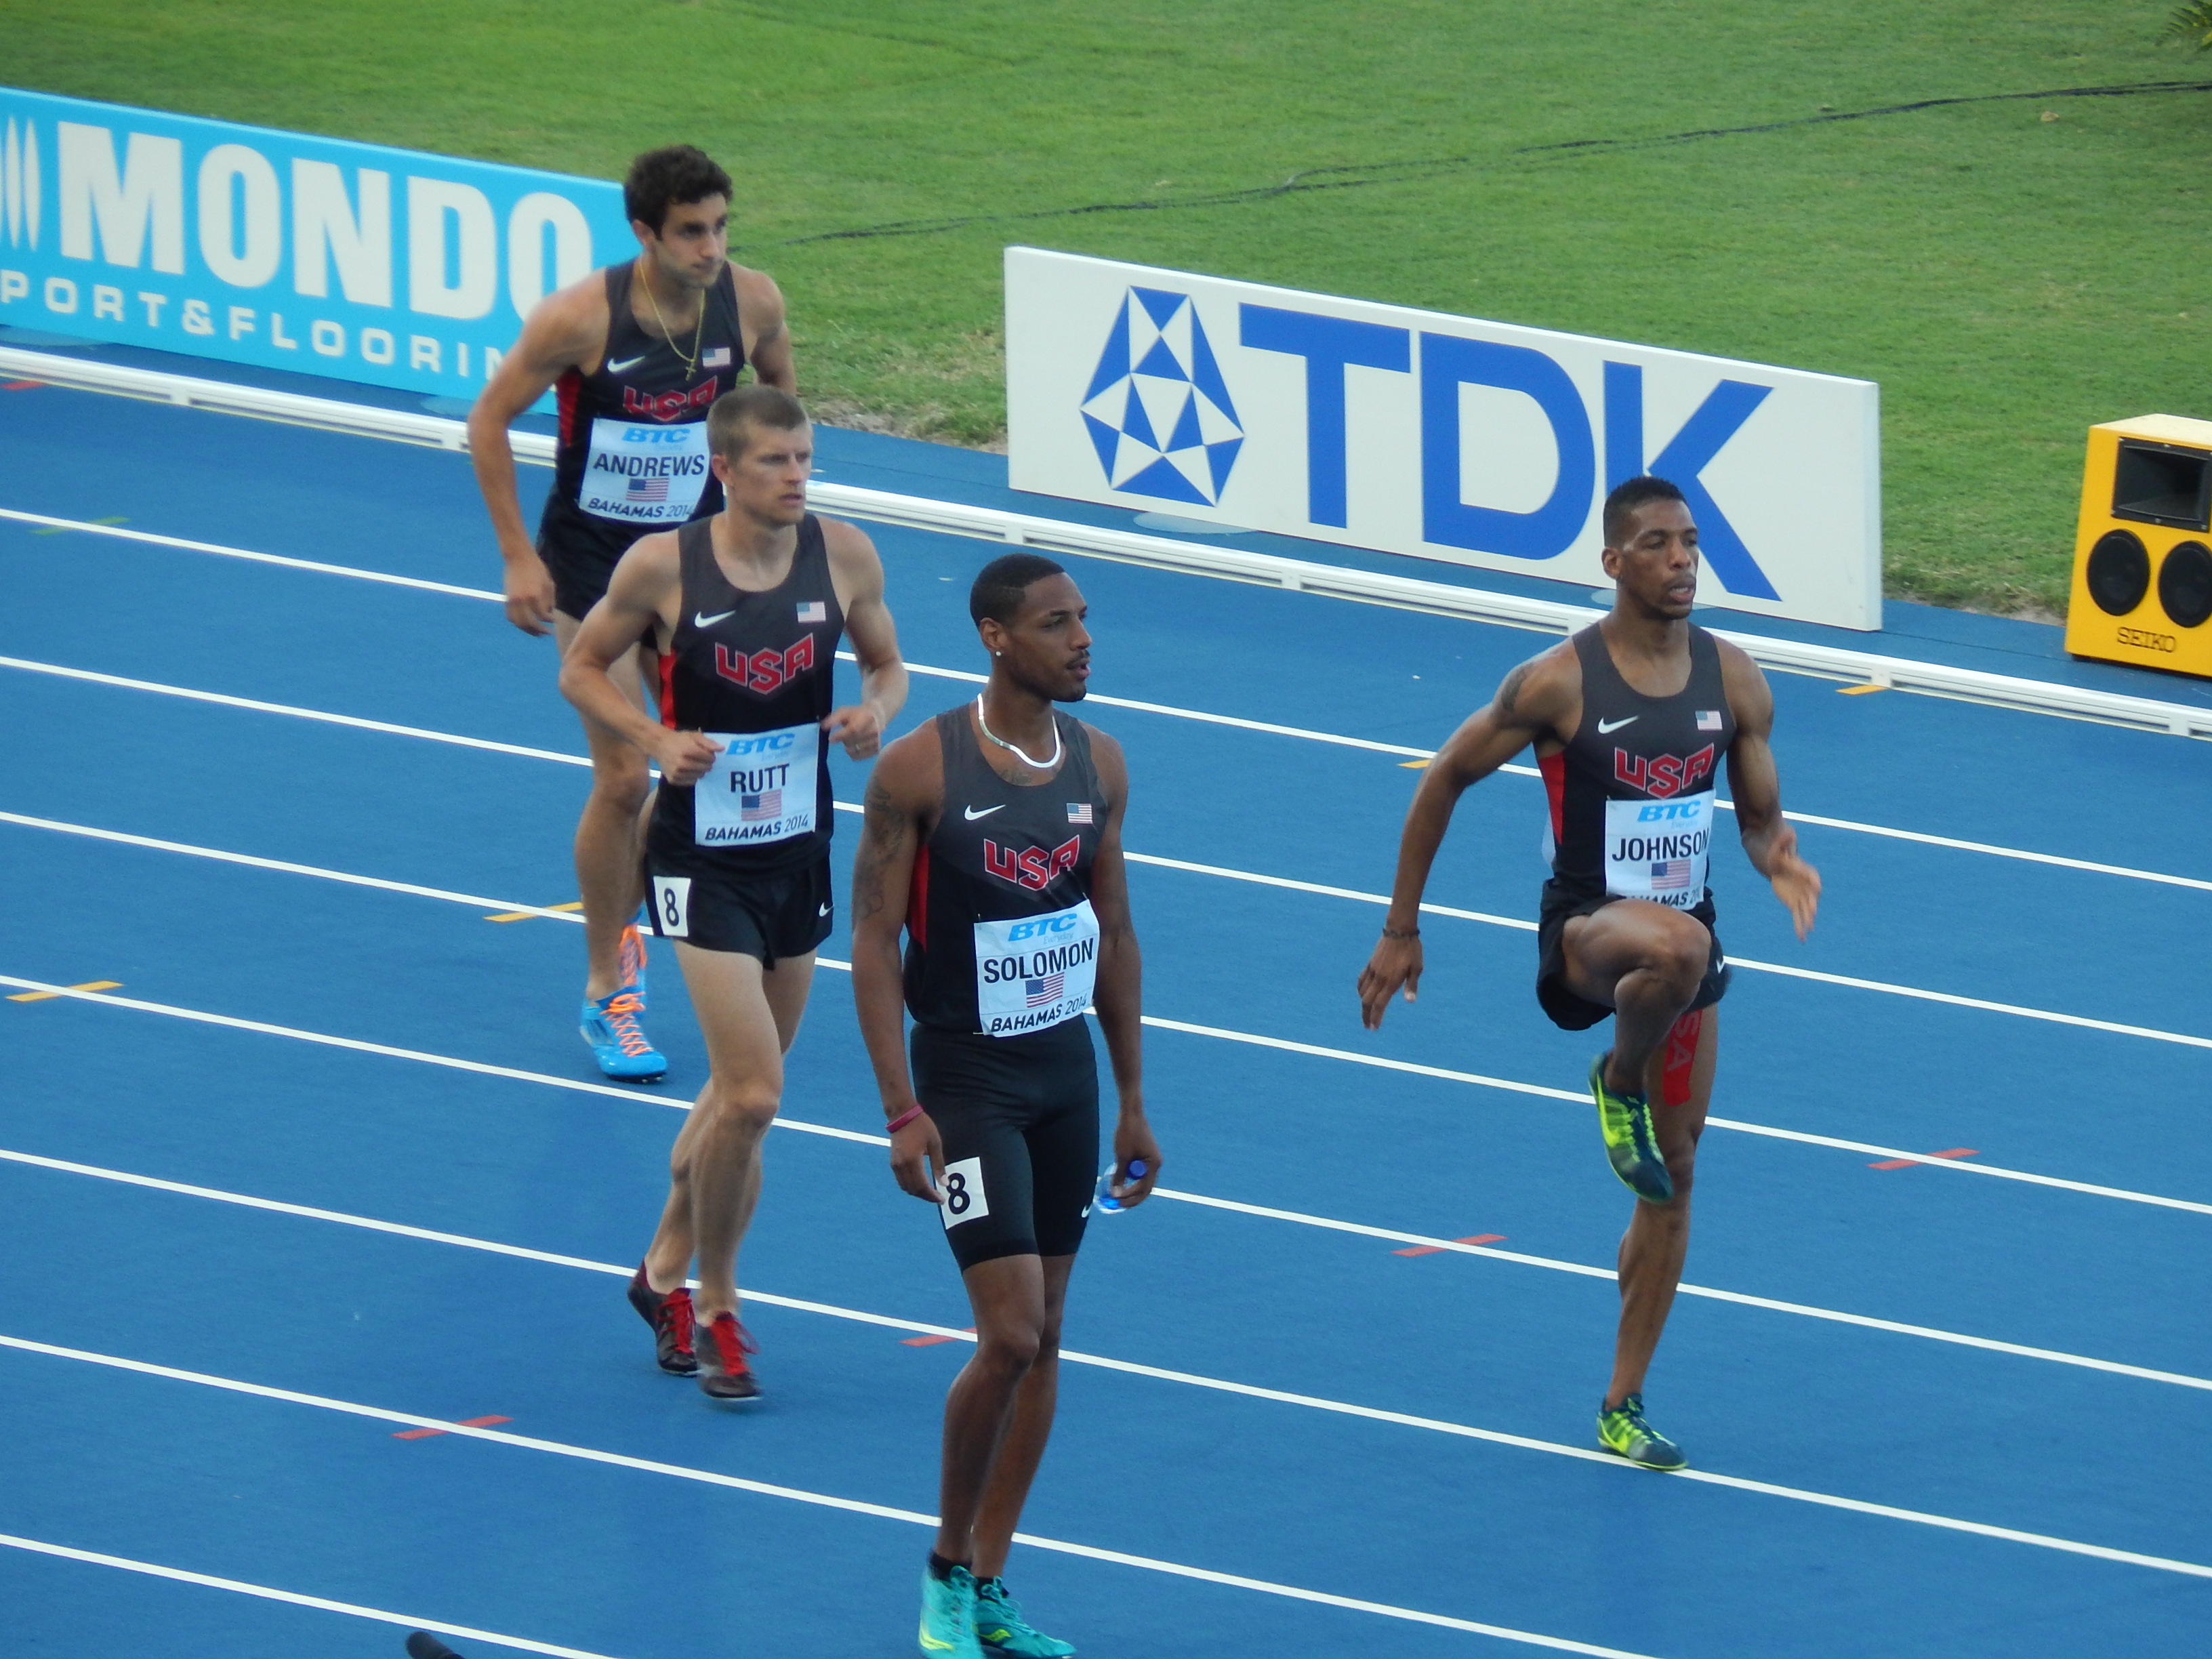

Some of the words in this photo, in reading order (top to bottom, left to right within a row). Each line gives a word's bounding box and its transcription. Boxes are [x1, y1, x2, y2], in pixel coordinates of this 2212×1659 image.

[58, 121, 592, 323] MONDO
[623, 375, 718, 422] USA
[621, 427, 691, 443] BTC
[1240, 302, 1782, 601] TDK
[593, 453, 705, 476] ANDREWS
[588, 497, 664, 518] BAHAMAS
[2117, 626, 2177, 653] SEIKO
[715, 632, 813, 695] USA
[726, 733, 795, 755] BTC
[730, 763, 790, 793] RUTT
[1614, 742, 1714, 800] USA
[705, 821, 781, 840] BAHAMAS
[784, 814, 808, 832] 2014
[1637, 801, 1701, 821] BTC
[1612, 827, 1709, 861] JOHNSON
[984, 834, 1080, 891] USA
[664, 888, 679, 926] 8
[1008, 914, 1078, 941] BTC
[983, 937, 1094, 983] SOLOMON
[991, 1003, 1061, 1033] BAHAMAS
[1066, 994, 1087, 1015] 2014
[947, 1172, 970, 1215] 8
